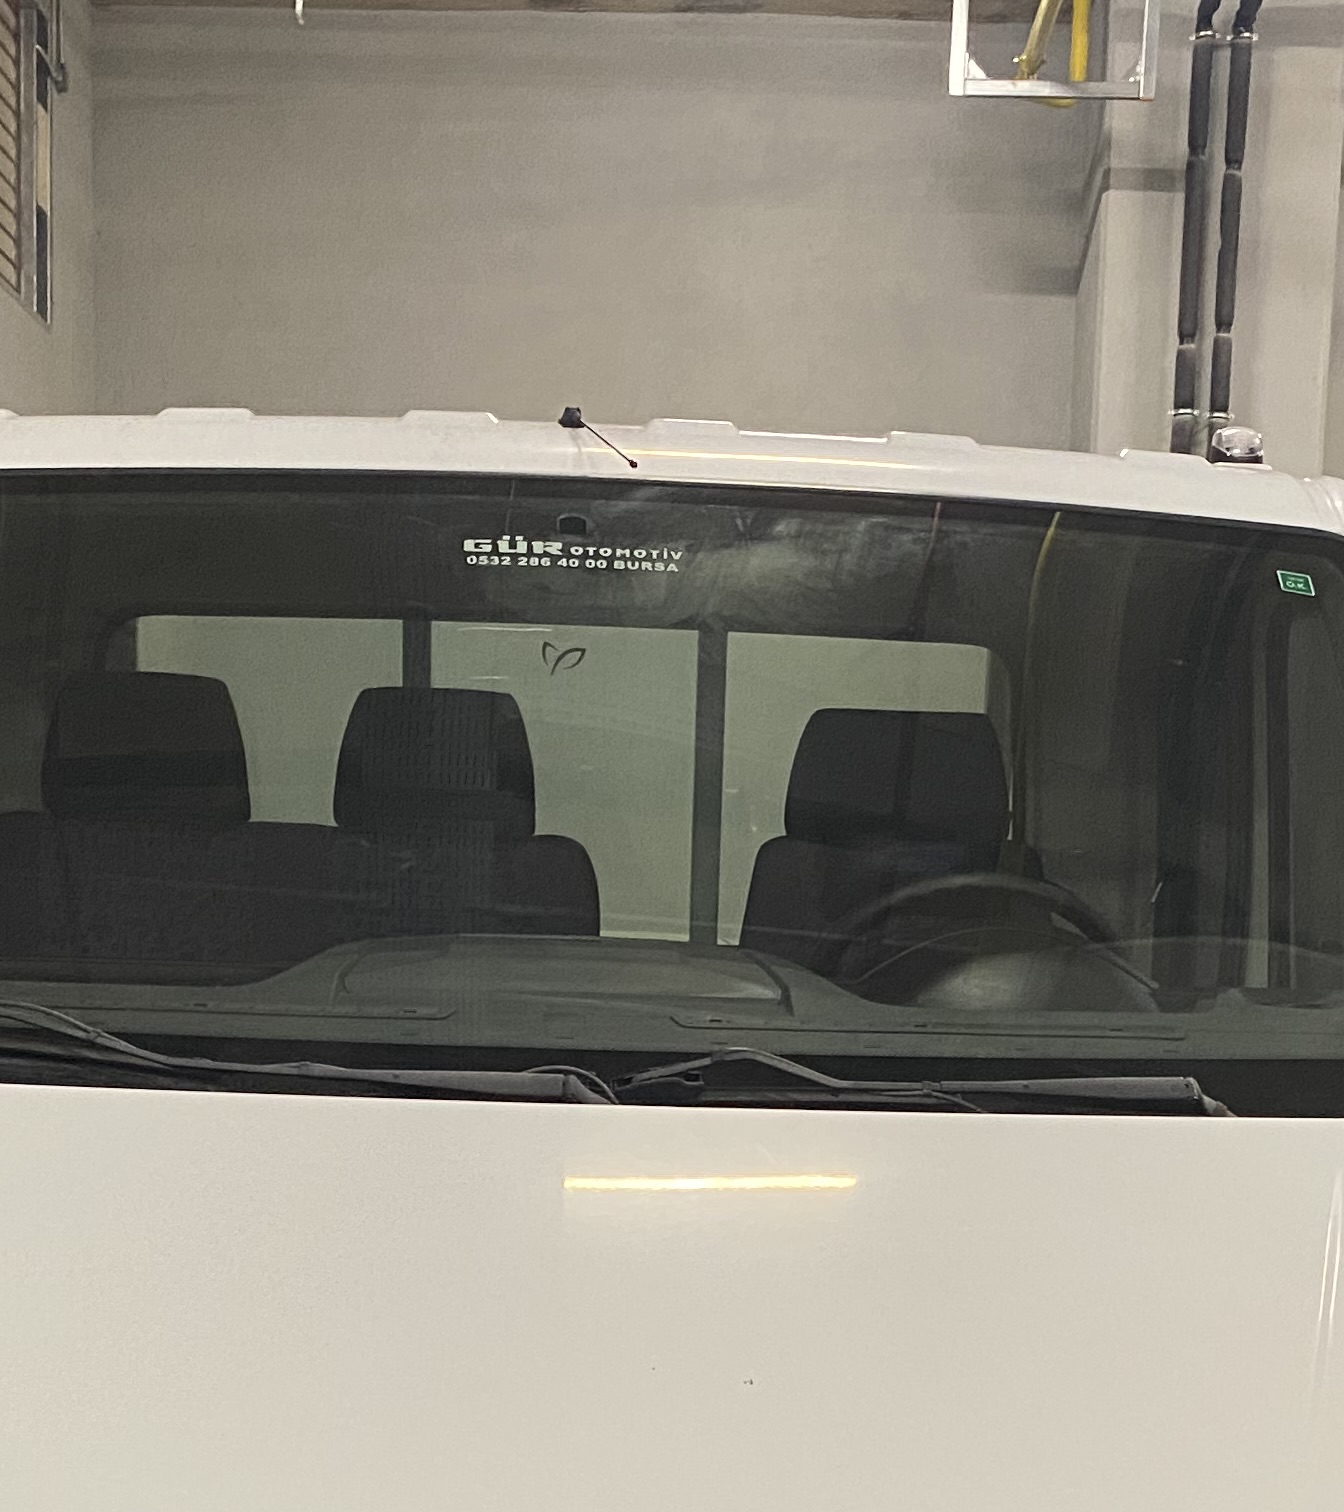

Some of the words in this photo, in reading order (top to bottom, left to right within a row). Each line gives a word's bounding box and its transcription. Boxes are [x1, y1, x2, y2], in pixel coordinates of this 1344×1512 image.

[463, 535, 563, 556] GÜR
[569, 545, 683, 561] OTOMOTİV
[466, 555, 512, 566] 0532
[517, 556, 551, 567] 286
[557, 558, 579, 568] 40
[585, 558, 608, 569] 00
[613, 560, 679, 572] BURSA
